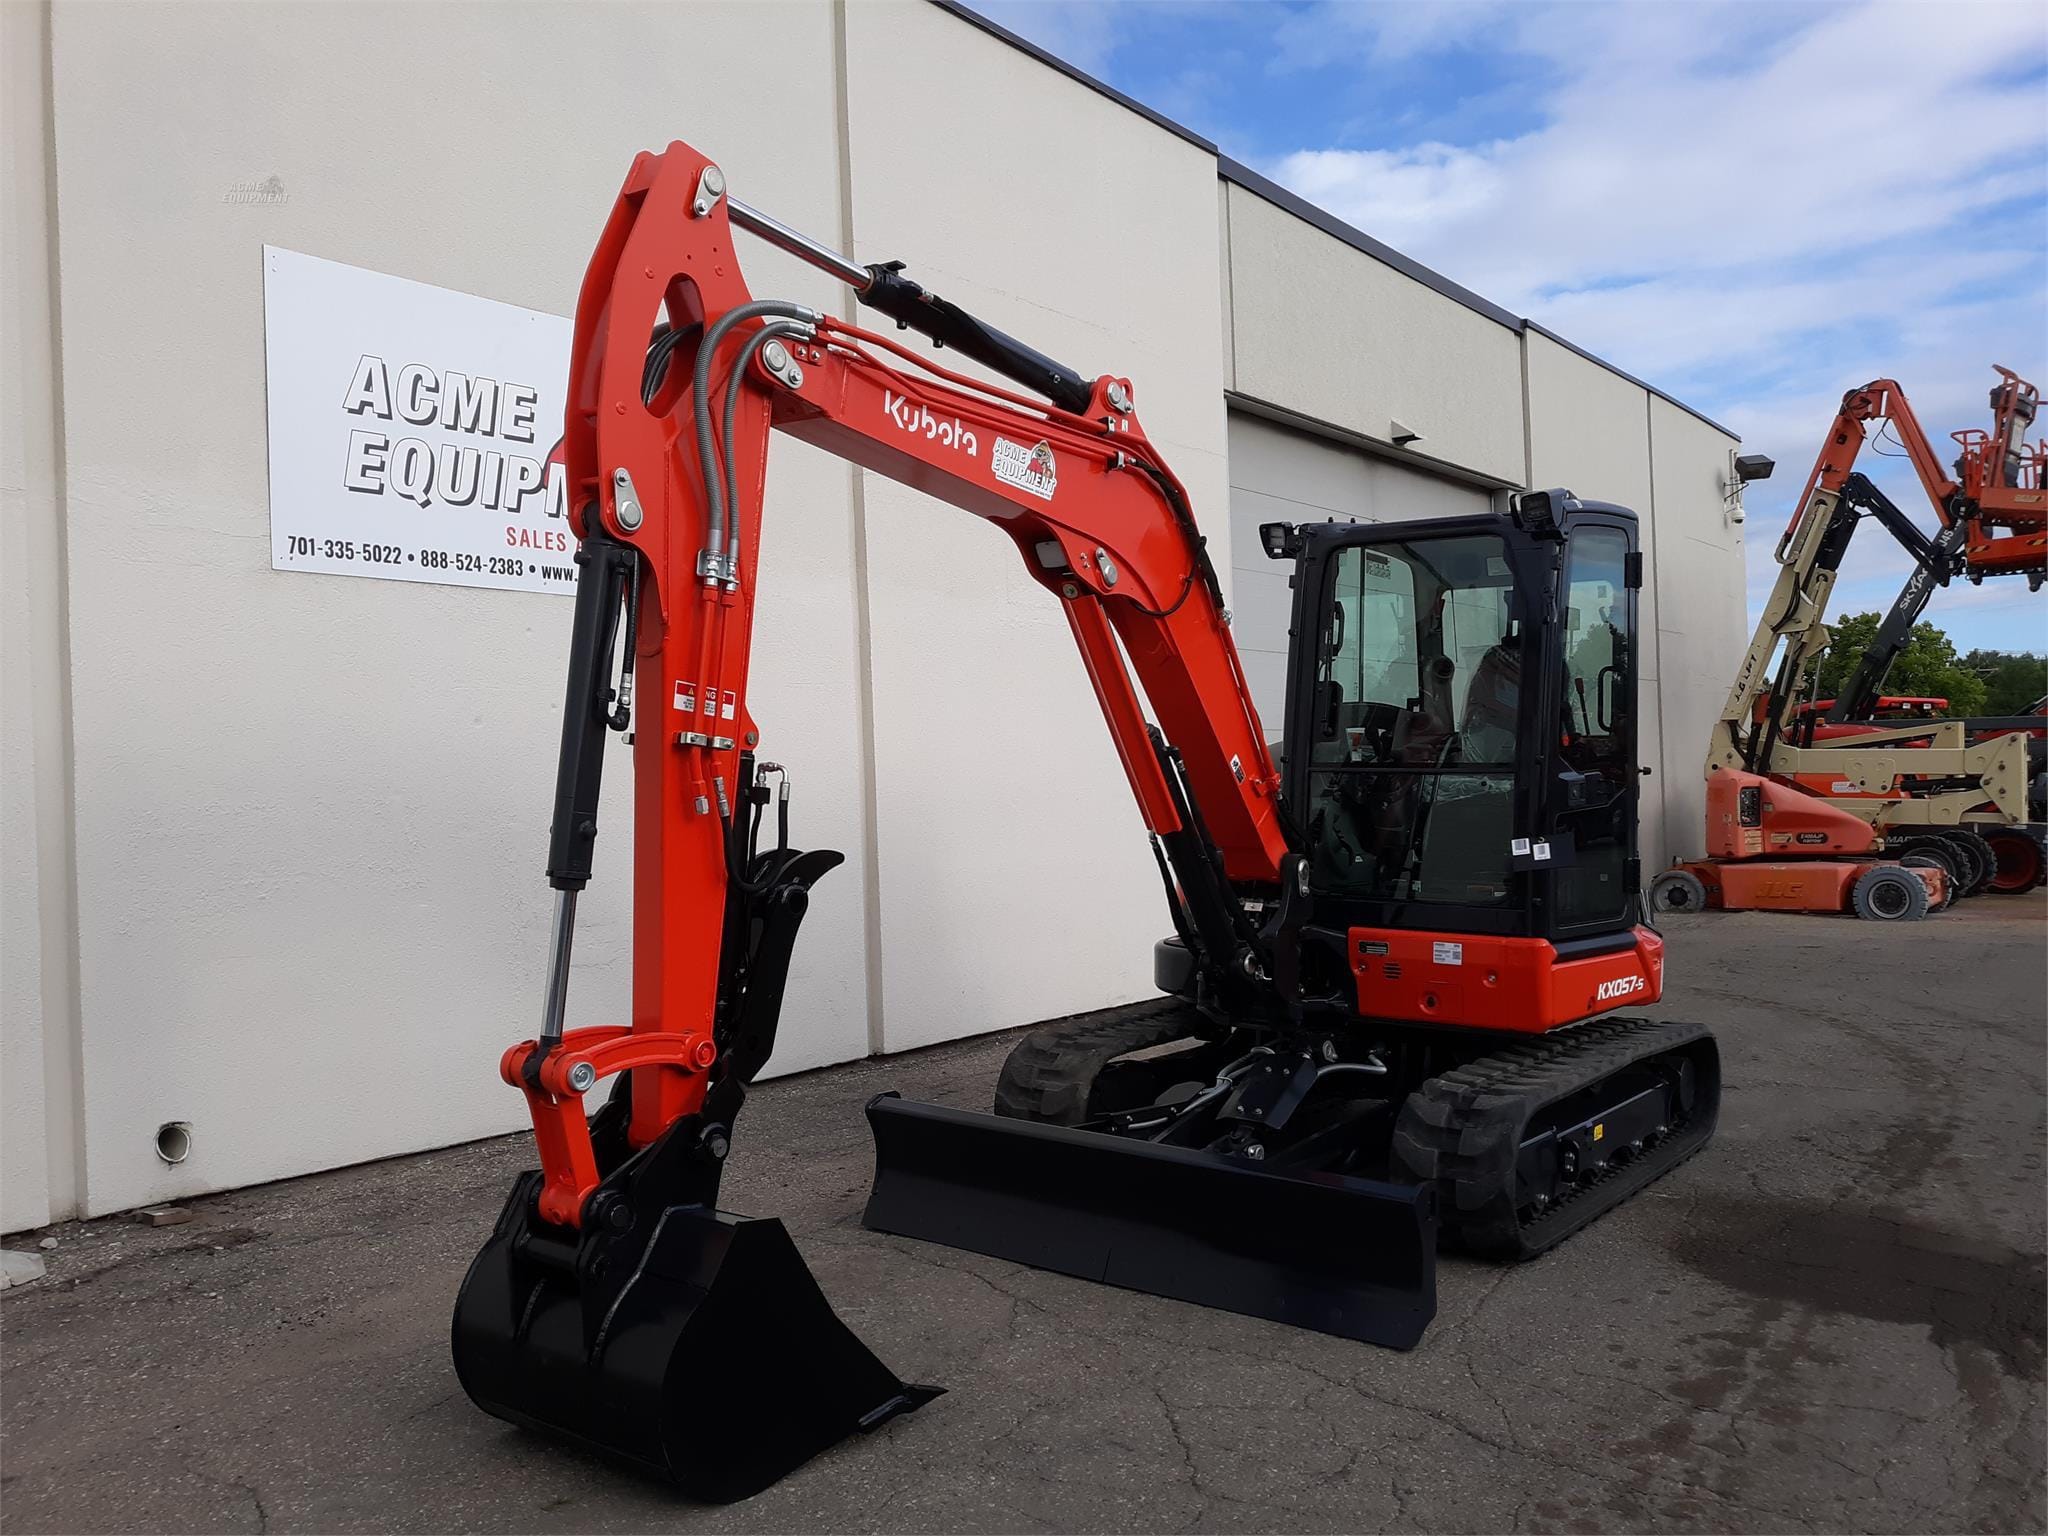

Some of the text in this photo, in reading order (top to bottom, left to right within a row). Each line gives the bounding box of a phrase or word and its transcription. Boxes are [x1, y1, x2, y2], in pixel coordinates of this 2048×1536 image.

[342, 354, 537, 443] ACME
[884, 389, 977, 456] Kubota
[995, 438, 1027, 464] ACME
[993, 456, 1055, 493] EQUIPMENT
[288, 535, 578, 582] 701-335-5022 888-524-2383 www.
[506, 526, 567, 552] SALES
